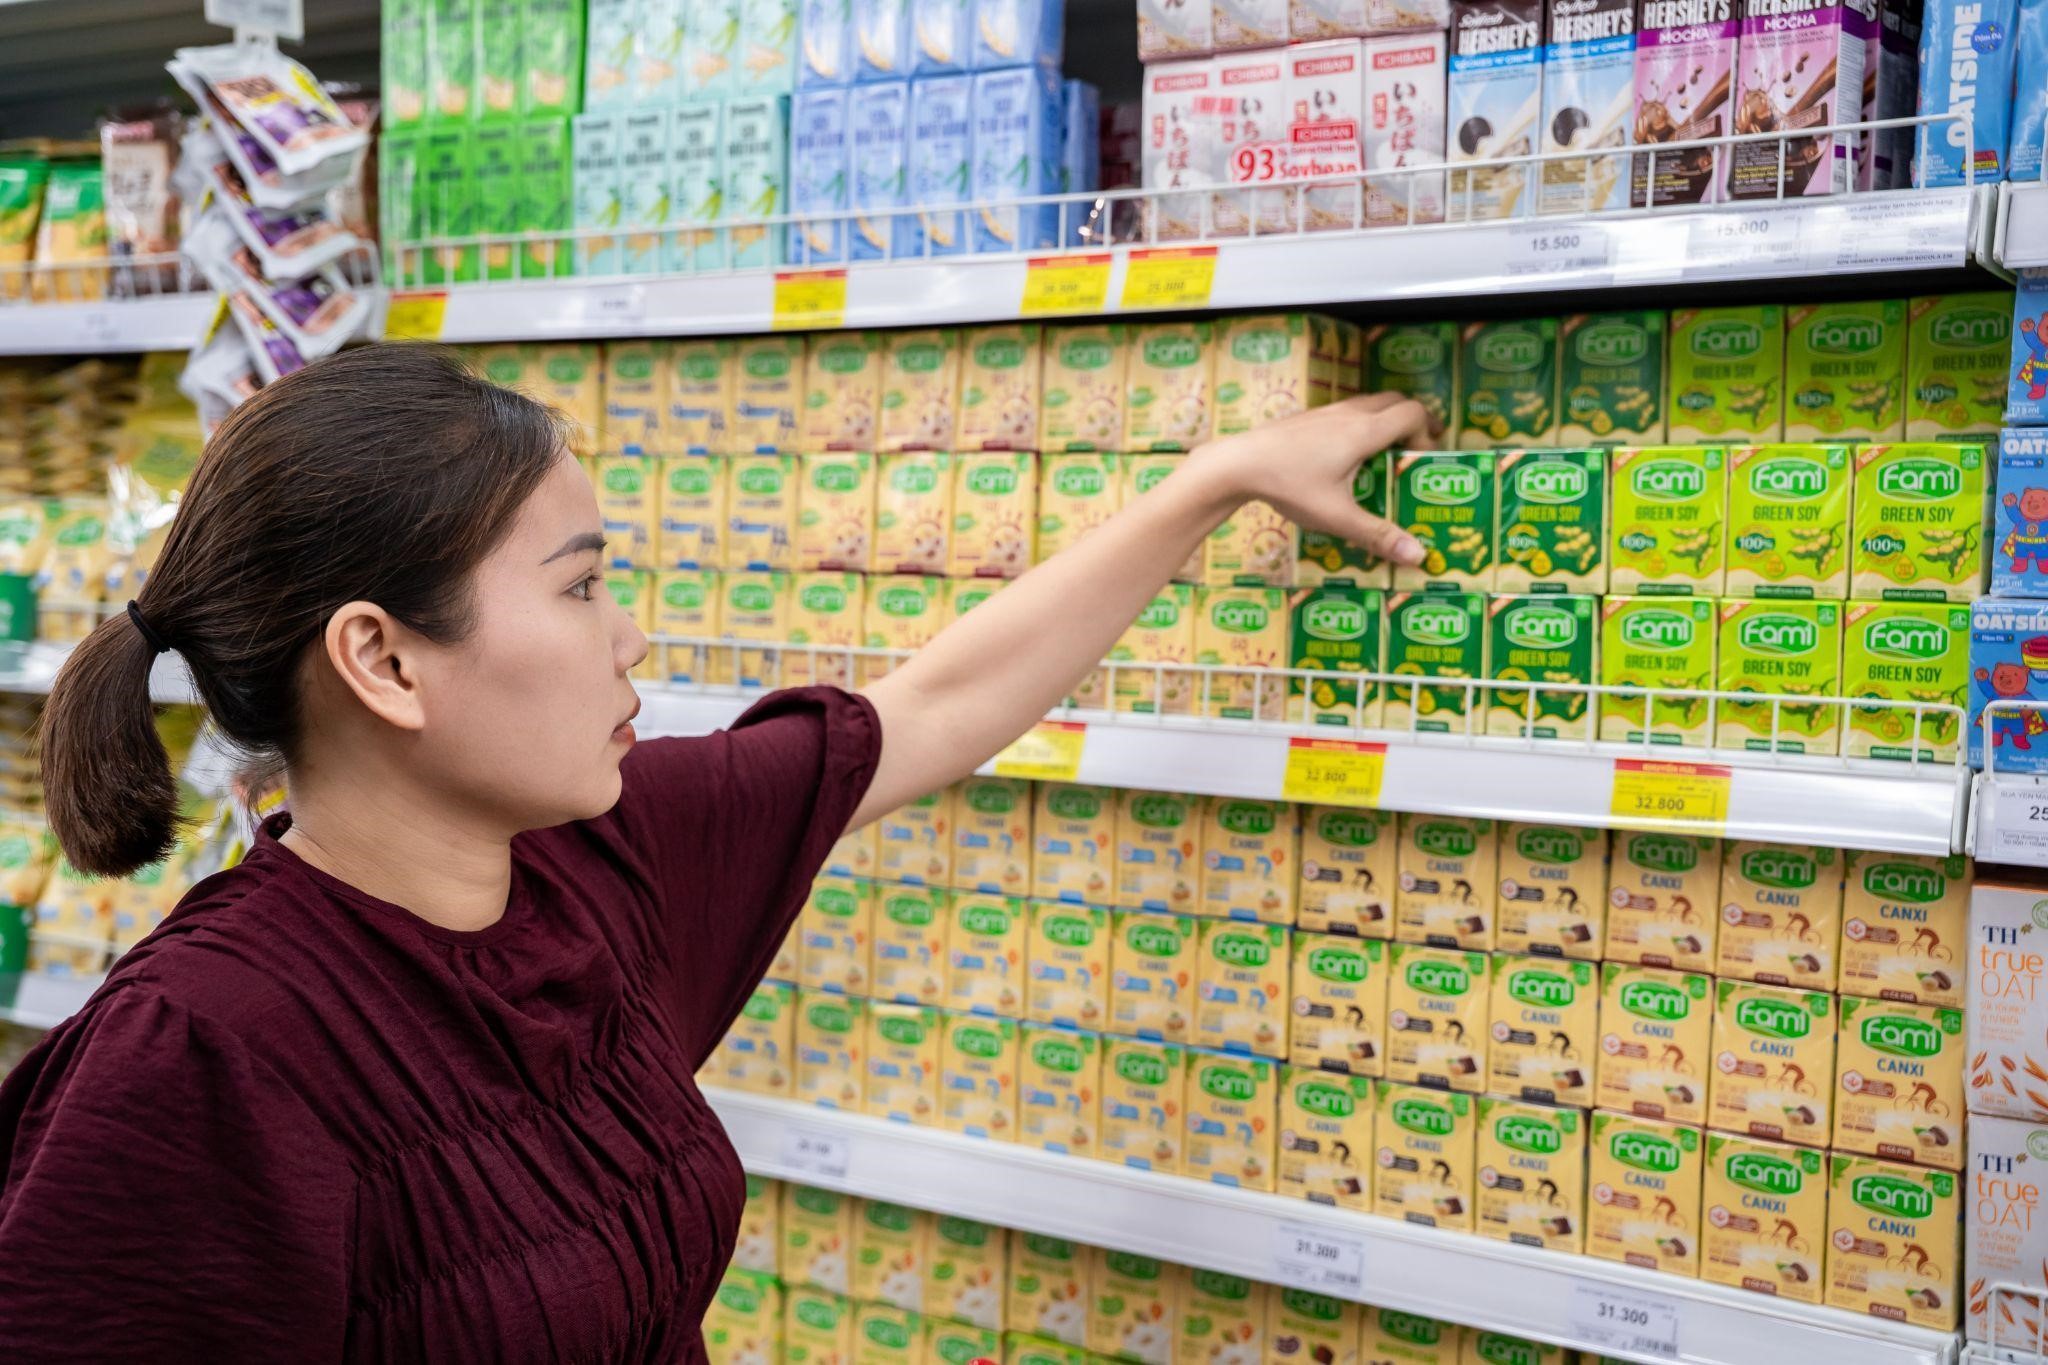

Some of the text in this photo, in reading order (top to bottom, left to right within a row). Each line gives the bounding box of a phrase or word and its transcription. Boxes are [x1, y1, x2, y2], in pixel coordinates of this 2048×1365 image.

[1552, 8, 1633, 43] HERSHEY'S
[1764, 13, 1816, 31] MOCHA
[1458, 21, 1538, 56] HERSHEY'S
[1659, 29, 1710, 45] MOCHA
[1301, 60, 1348, 73] ICHIBAN
[1378, 51, 1431, 66] ICHIBAN
[1947, 3, 1981, 147] OATSIDE
[1239, 149, 1274, 181] 93
[1531, 234, 1580, 252] 15.500
[1636, 505, 1699, 521] GREEN SOY
[1753, 505, 1822, 521] GREEN SOY
[1881, 506, 1955, 522] GREEN SOY
[1739, 537, 1774, 551] 100%
[1865, 538, 1903, 552] 100%
[1625, 655, 1688, 671] GREEN SOY
[1743, 659, 1811, 677] GREEN SOY
[1868, 664, 1942, 683] GREEN SOY
[1635, 796, 1685, 811] 32.800
[1641, 873, 1683, 890] CANXI
[1756, 890, 1800, 907] CANXI
[1880, 905, 1928, 923] CANXI
[1982, 925, 2017, 944] TH
[1981, 944, 2043, 974] true
[1981, 970, 2042, 1001] OAT
[1633, 1022, 1674, 1039] CANXI
[1750, 1040, 1794, 1058] CANXI
[1877, 1058, 1924, 1077] CANXI
[1977, 1152, 2012, 1173] TH
[1624, 1172, 1666, 1190] CANXI
[1977, 1172, 2039, 1201] true
[1742, 1194, 1786, 1213] CANXI
[1977, 1200, 2036, 1232] OAT
[1868, 1218, 1916, 1238] CANXI
[1597, 1302, 1648, 1326] 31.300
